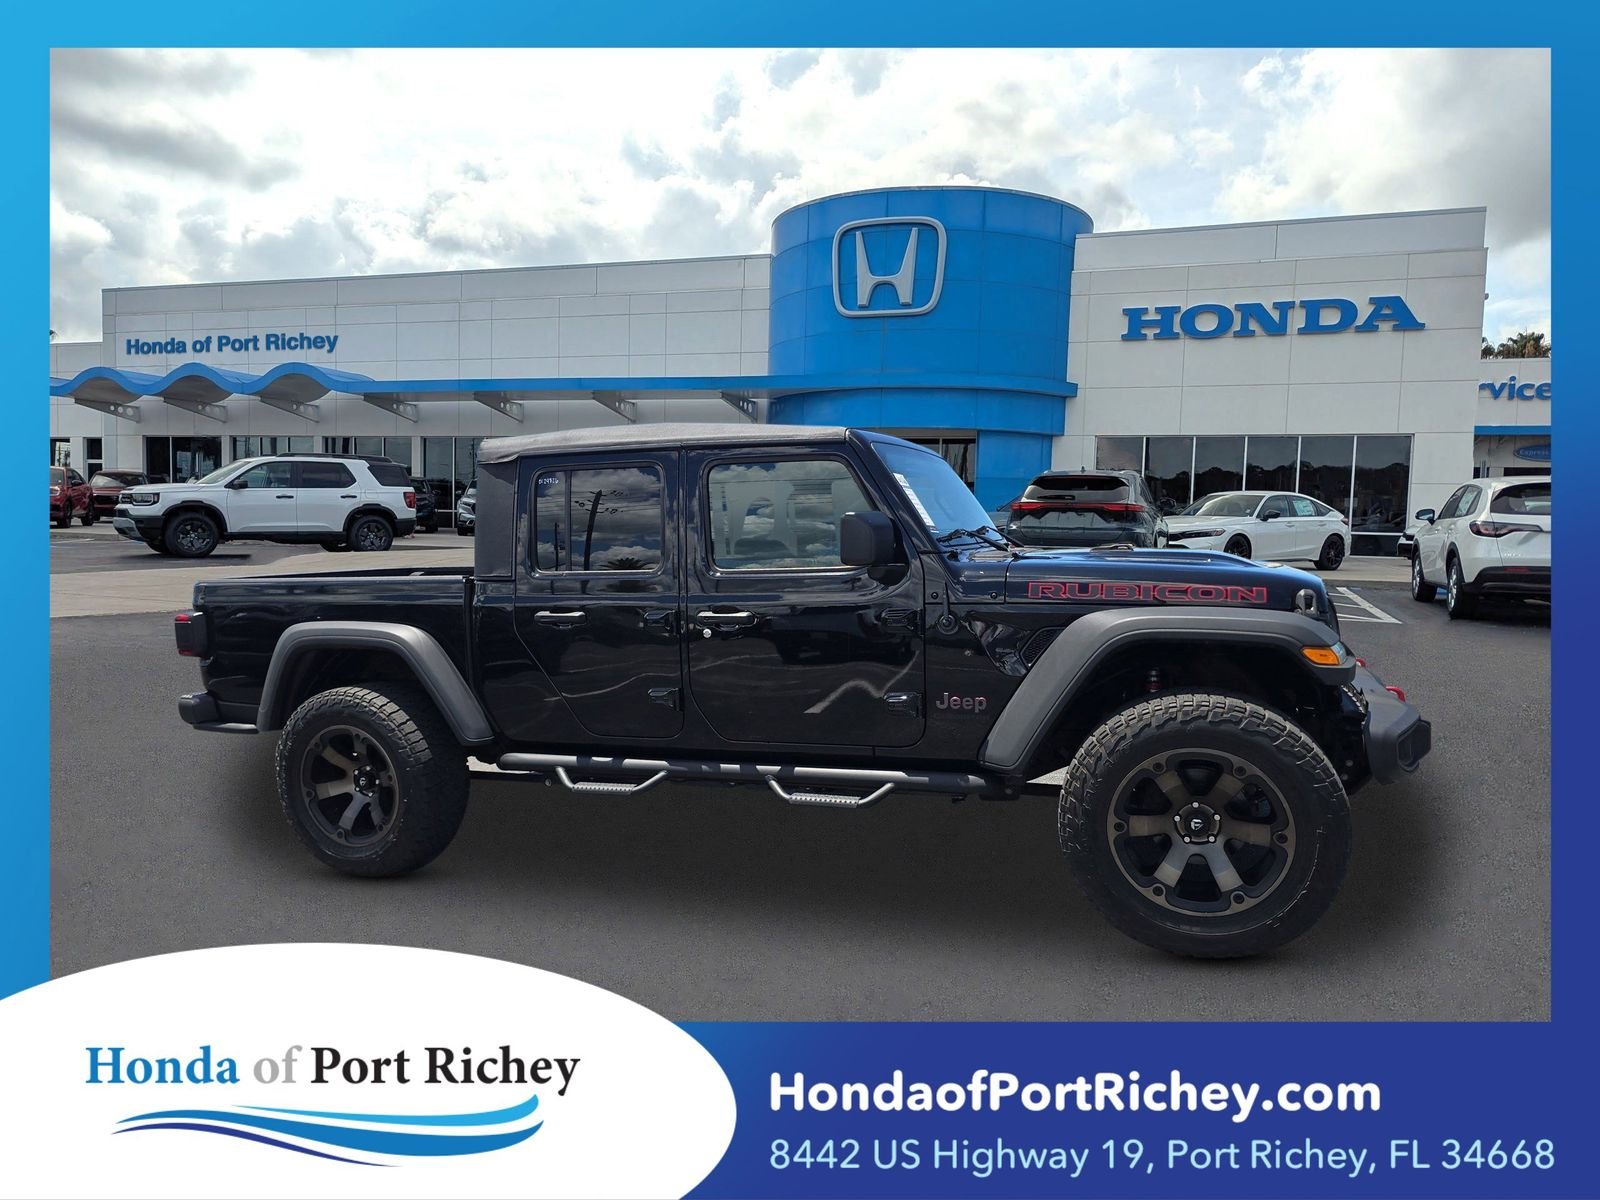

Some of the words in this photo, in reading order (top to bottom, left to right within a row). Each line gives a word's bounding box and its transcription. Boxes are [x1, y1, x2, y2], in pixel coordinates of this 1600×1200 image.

[1121, 295, 1425, 341] HONDA
[126, 338, 187, 355] Honda
[191, 336, 212, 353] of
[217, 335, 260, 353] Port
[265, 332, 338, 353] Richey
[1028, 581, 1268, 603] RUBICON
[935, 692, 987, 713] Jeep
